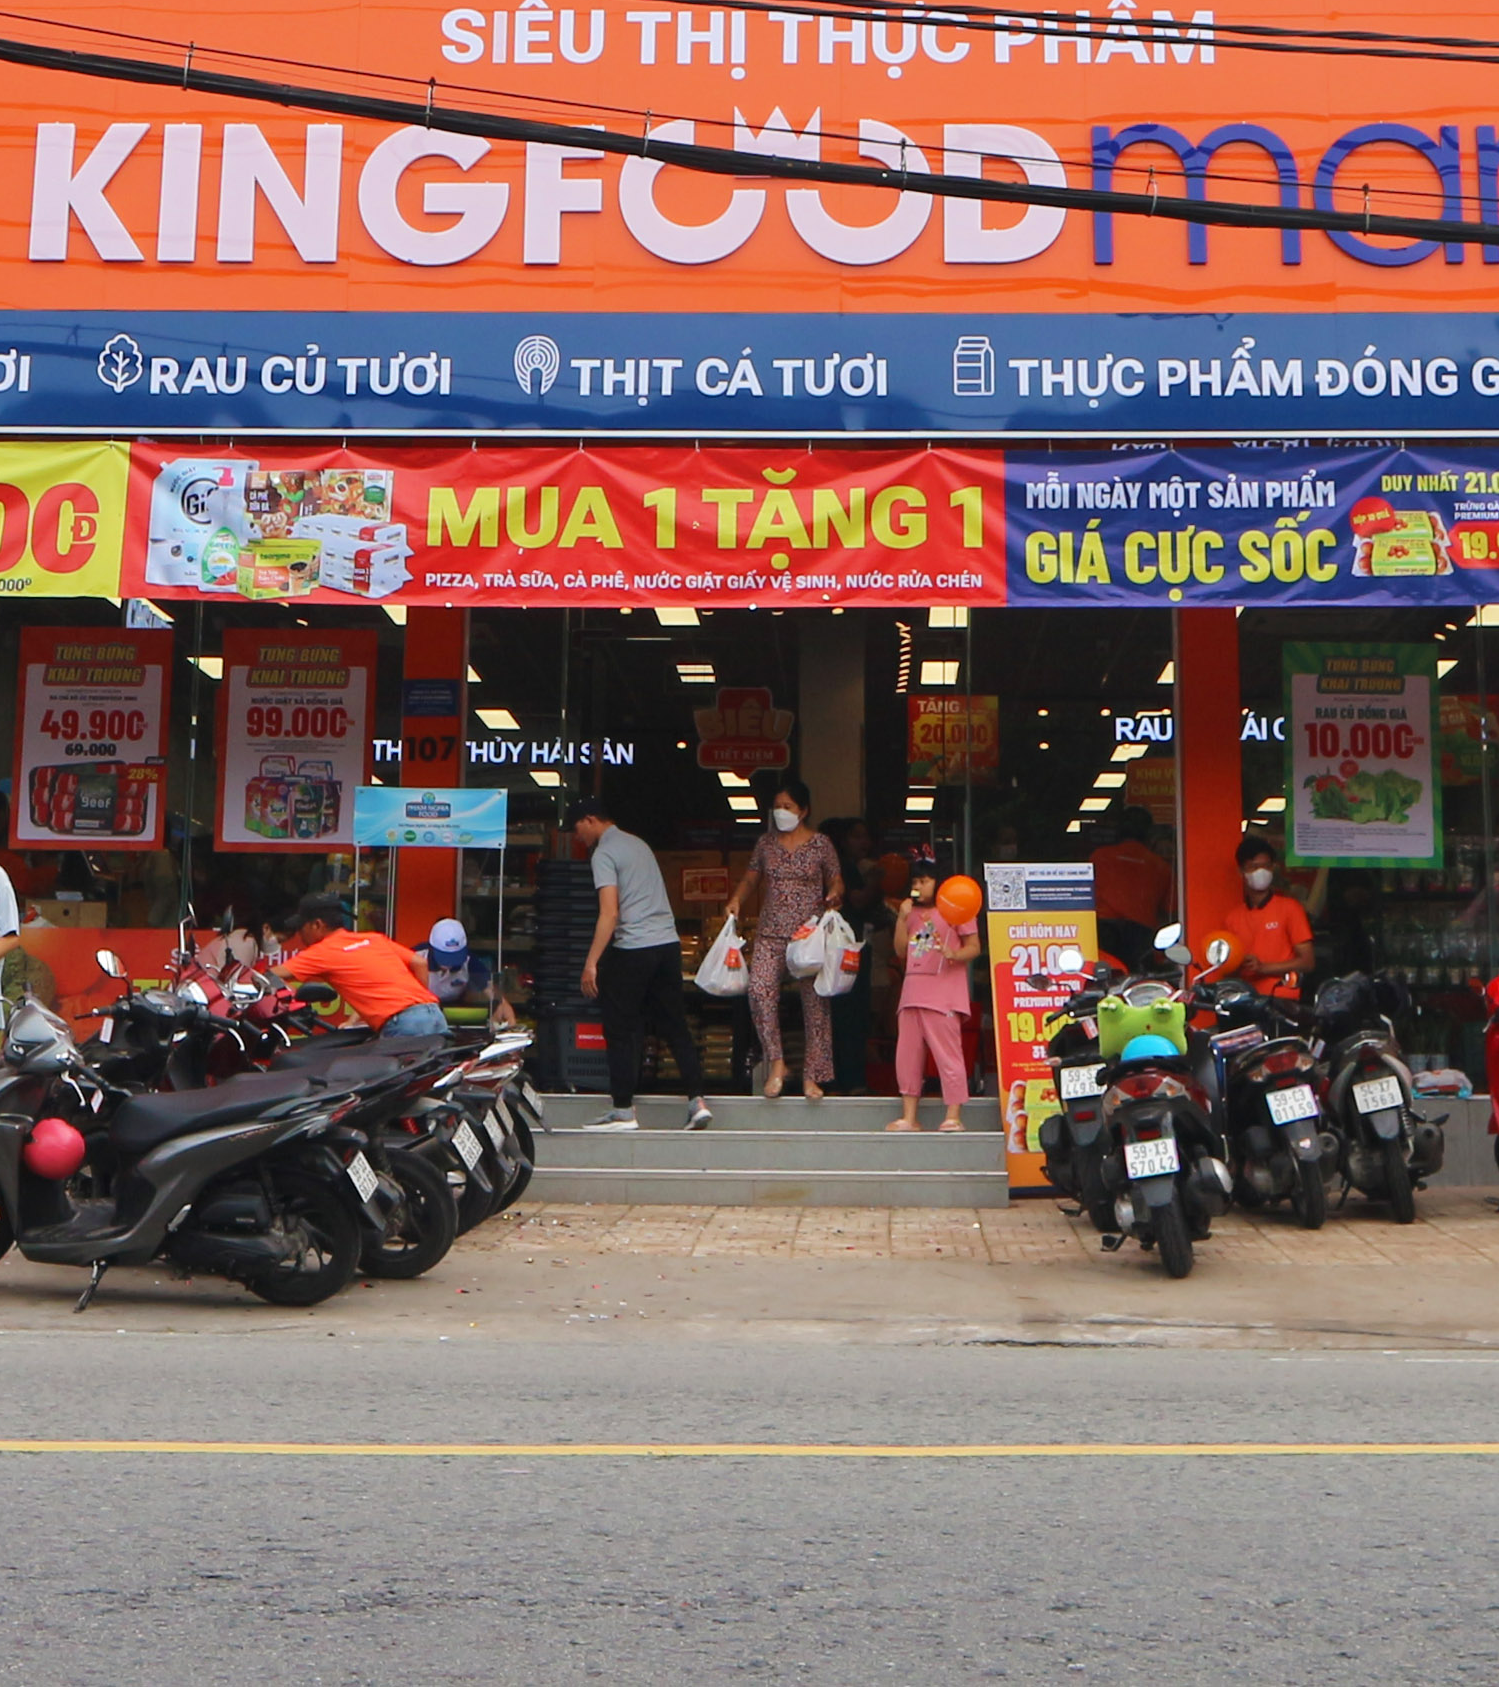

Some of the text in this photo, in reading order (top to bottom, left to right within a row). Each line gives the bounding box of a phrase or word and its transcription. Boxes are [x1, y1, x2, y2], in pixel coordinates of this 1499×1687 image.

[625, 7, 747, 81] THỊ
[768, 2, 971, 80] THỰC
[148, 344, 452, 396] RAU CỦ TƯƠI
[571, 347, 888, 407] THỊT CÁ TƯƠI
[1008, 353, 1145, 409] THỰC
[1157, 336, 1304, 397] PHẨM
[1314, 344, 1458, 397] ĐÓNG
[1025, 468, 1336, 517] MỖI NGÀY MỘT SẢN PHẨM
[1381, 474, 1413, 493] DUY
[1416, 469, 1459, 493] NHẤT
[426, 467, 984, 570] MUA 1 TẶNG 1
[1453, 500, 1486, 512] TRỨNG
[1453, 511, 1499, 520] PREMIUM
[1024, 510, 1339, 602] GIÁ CỰC SỐC
[424, 568, 983, 593] PIZZA, TRÀ SỮA, CÀ PHÊ, NƯỚC GIẶT GIẤY VỆ SINH, NƯỚC RỬA CHÉN
[40, 708, 145, 742] 49.900
[246, 706, 349, 739] 99.000
[1315, 706, 1338, 720] RAU
[1115, 716, 1175, 742] RAU
[1303, 722, 1415, 759] 10.000
[64, 742, 118, 757] 69.000
[404, 736, 457, 762] 107
[1007, 922, 1078, 940] CHỈ HÔM NAY
[1012, 994, 1054, 1009] PREMIUM
[1130, 1156, 1176, 1178] 570.42
